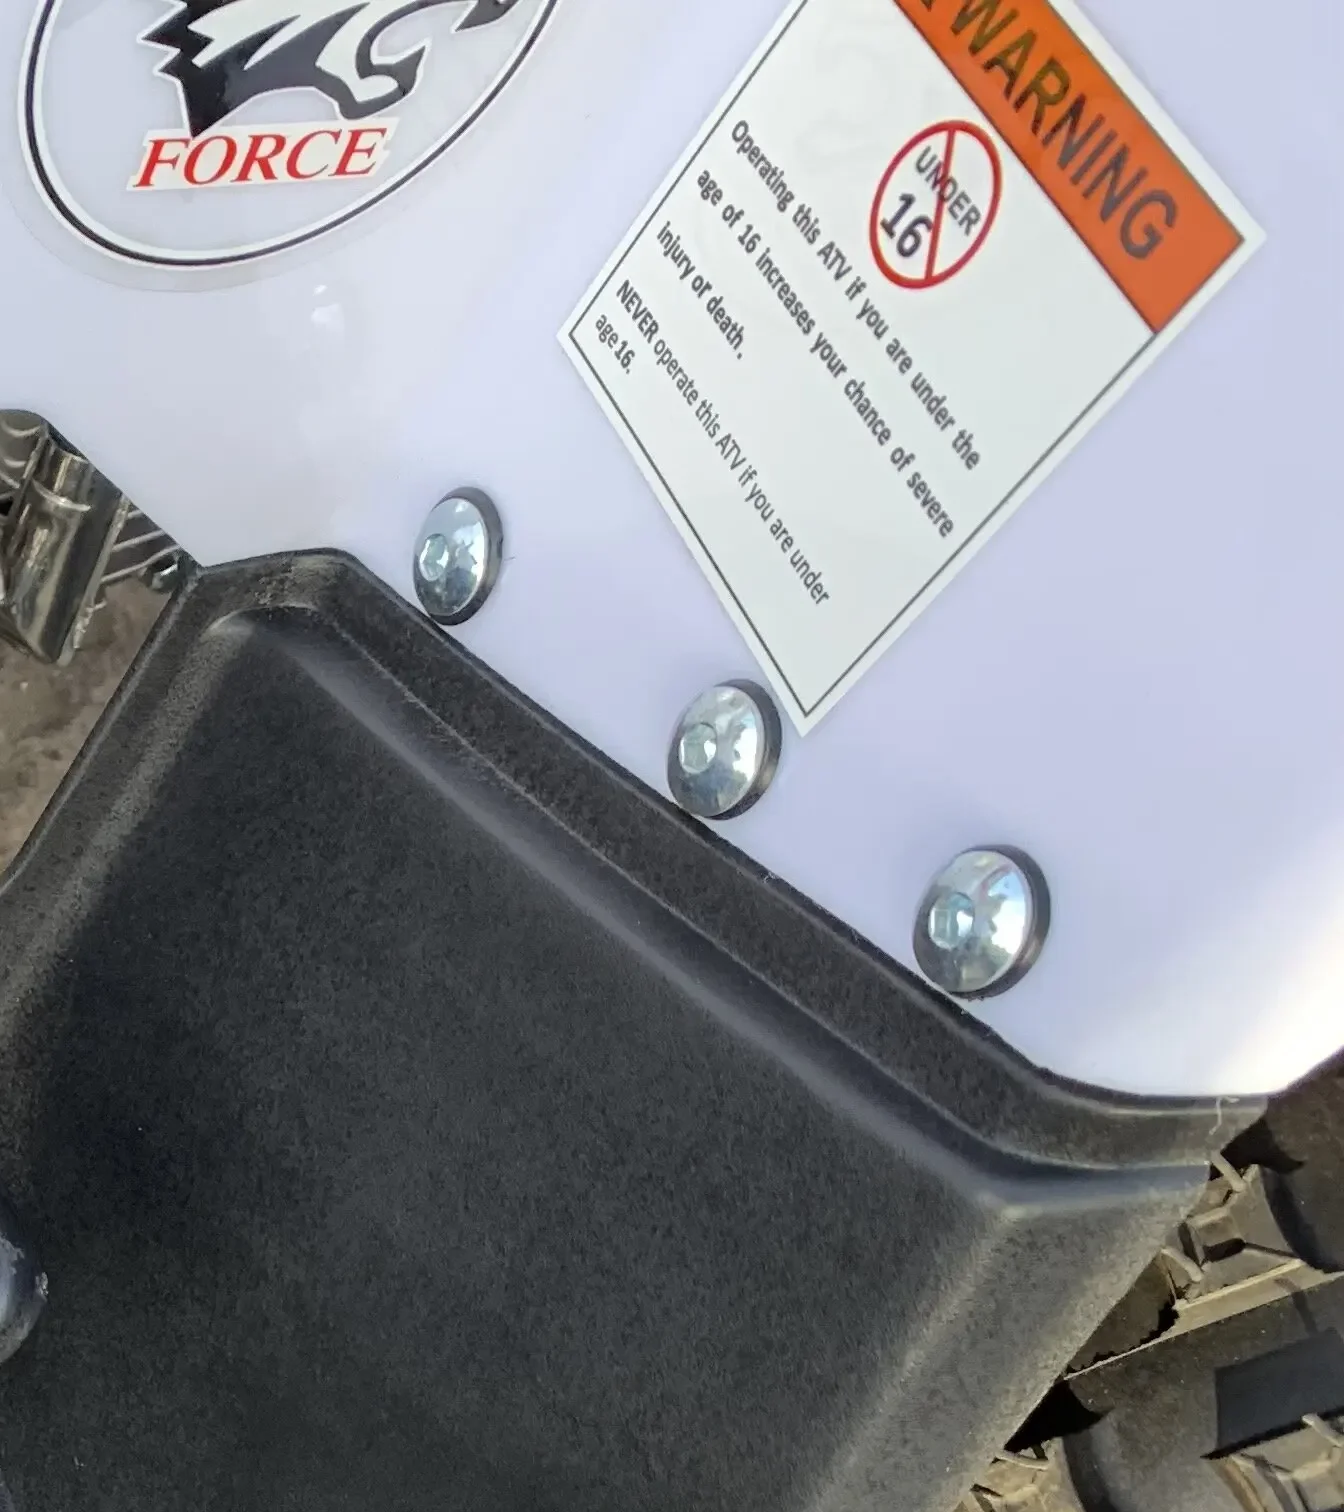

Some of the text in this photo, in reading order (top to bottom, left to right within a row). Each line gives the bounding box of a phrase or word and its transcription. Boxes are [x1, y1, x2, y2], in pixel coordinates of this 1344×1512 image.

[134, 126, 388, 188] FORCE
[915, 146, 981, 236] UNDER
[950, 0, 1178, 260] WARNING
[657, 221, 696, 280] injury
[691, 274, 712, 298] or
[731, 120, 980, 470] Operating this ATV if you are under the
[880, 193, 933, 258] 16
[697, 170, 954, 537] age of 16 increases your chance of severe
[616, 280, 829, 604] NEVER operate this ATV if you are under
